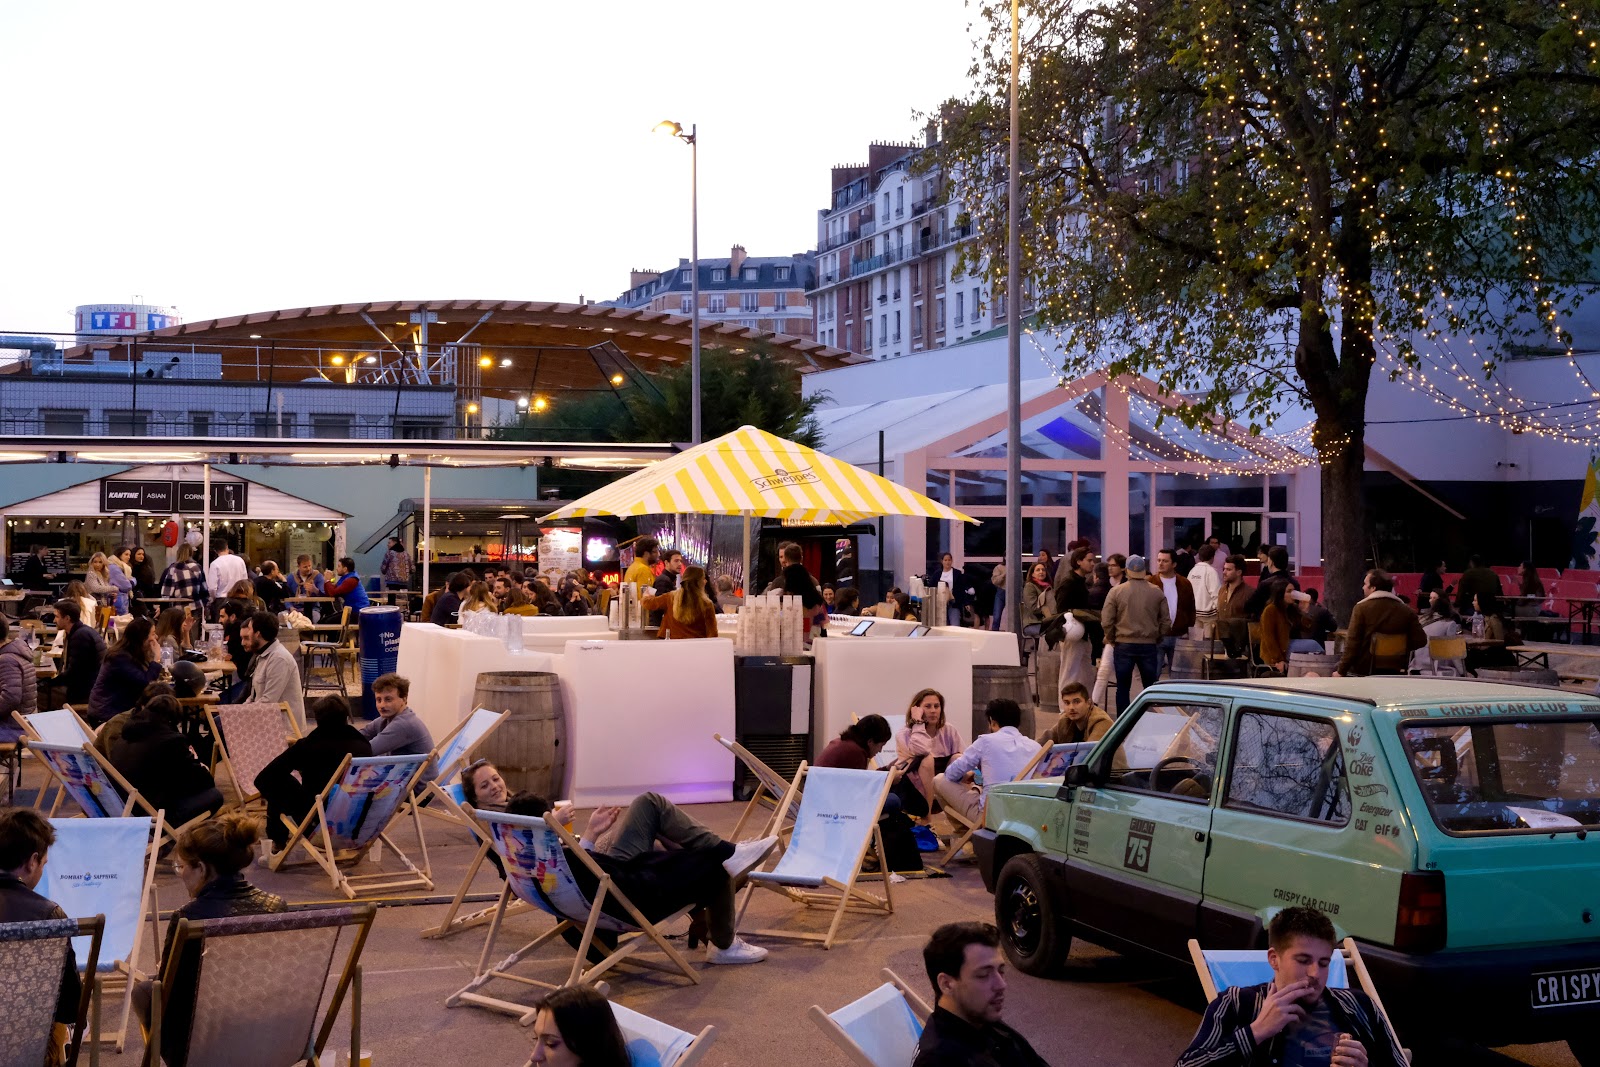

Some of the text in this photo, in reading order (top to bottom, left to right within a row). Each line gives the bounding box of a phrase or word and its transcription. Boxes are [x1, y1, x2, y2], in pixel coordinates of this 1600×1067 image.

[95, 315, 131, 327] TF1
[755, 471, 816, 489] Schweppes
[1400, 709, 1428, 717] FIAT
[1440, 702, 1569, 716] CRISPY CAR CLUB
[1358, 752, 1376, 762] Diet
[1350, 760, 1374, 776] Coke
[1360, 802, 1393, 817] Energizer
[1131, 819, 1155, 833] FIAT
[1355, 818, 1368, 830] CAT
[1375, 824, 1391, 835] elf
[1127, 837, 1149, 867] 75
[1425, 861, 1438, 869] elf
[1273, 888, 1340, 915] CRISPY CAR CLUB
[1537, 972, 1600, 1002] CRISPY
